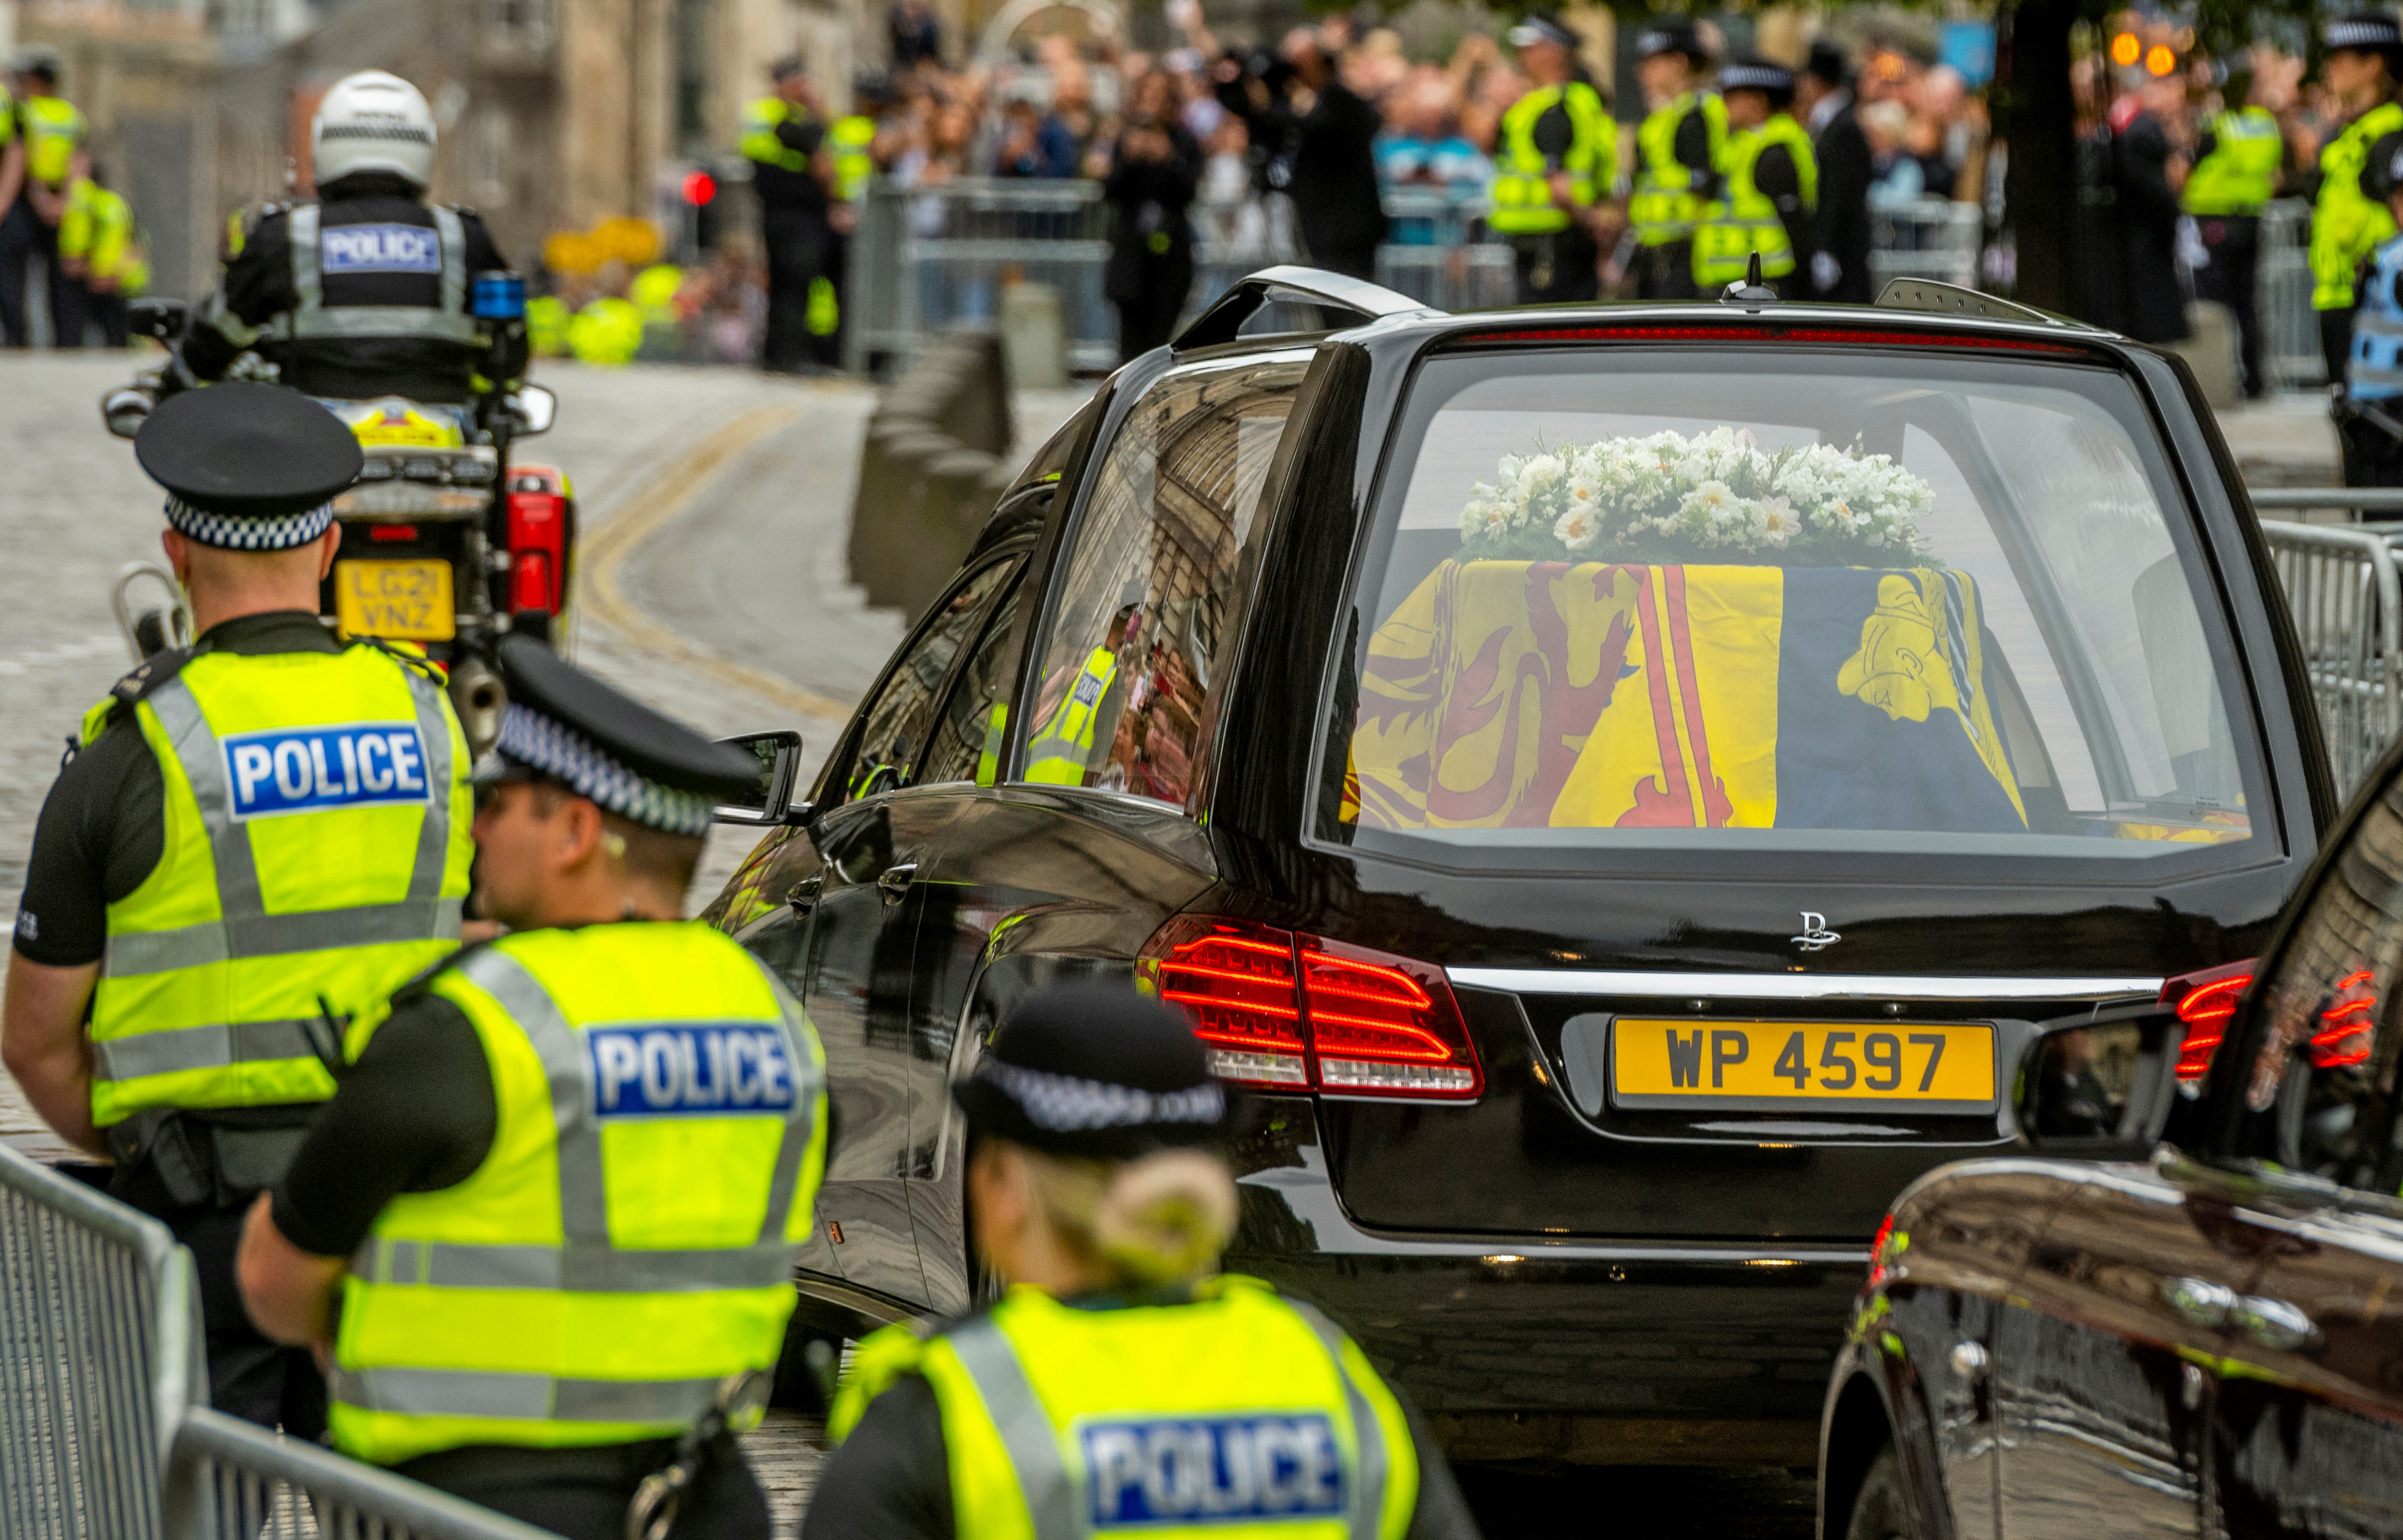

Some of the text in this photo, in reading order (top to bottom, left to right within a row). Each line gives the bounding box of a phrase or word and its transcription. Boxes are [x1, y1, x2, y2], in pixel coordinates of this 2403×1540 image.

[234, 733, 423, 805] POLICE
[596, 1032, 790, 1109] POLICE
[1666, 1029, 1946, 1092] WP 4597
[1094, 1423, 1337, 1516] POLICE
